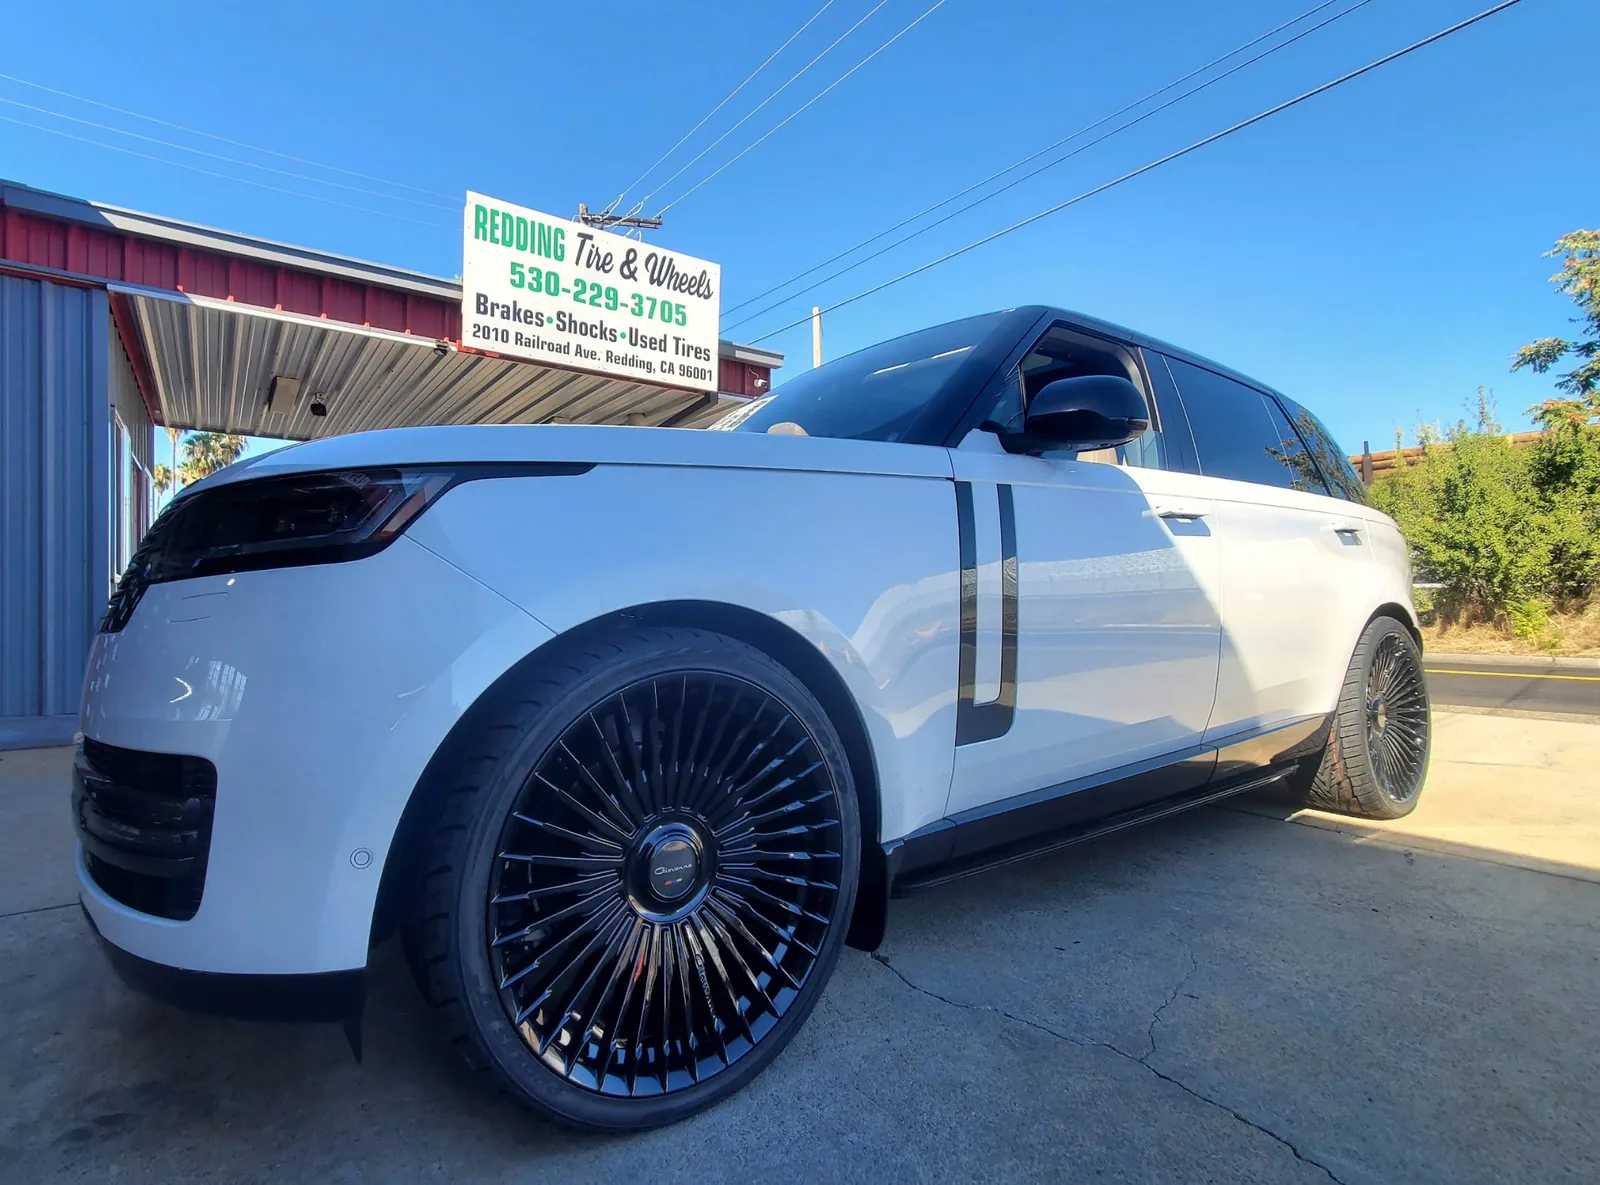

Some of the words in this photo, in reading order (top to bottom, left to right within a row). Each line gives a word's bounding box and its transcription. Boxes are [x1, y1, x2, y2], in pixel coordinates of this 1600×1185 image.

[474, 203, 565, 262] REDDING
[575, 231, 614, 274] Tire
[619, 247, 638, 282] &
[644, 252, 714, 300] Wheels
[475, 292, 544, 328] Brakes
[556, 310, 618, 343] Shocks
[628, 326, 667, 353] Used
[673, 336, 711, 362] Tires
[510, 261, 687, 326] 530-229-3705
[472, 323, 509, 344] 2010
[514, 331, 570, 355] Railroad
[575, 343, 601, 361] Ave.
[605, 350, 656, 374] Redding,
[660, 360, 675, 375] CA
[679, 364, 713, 382] 96001
